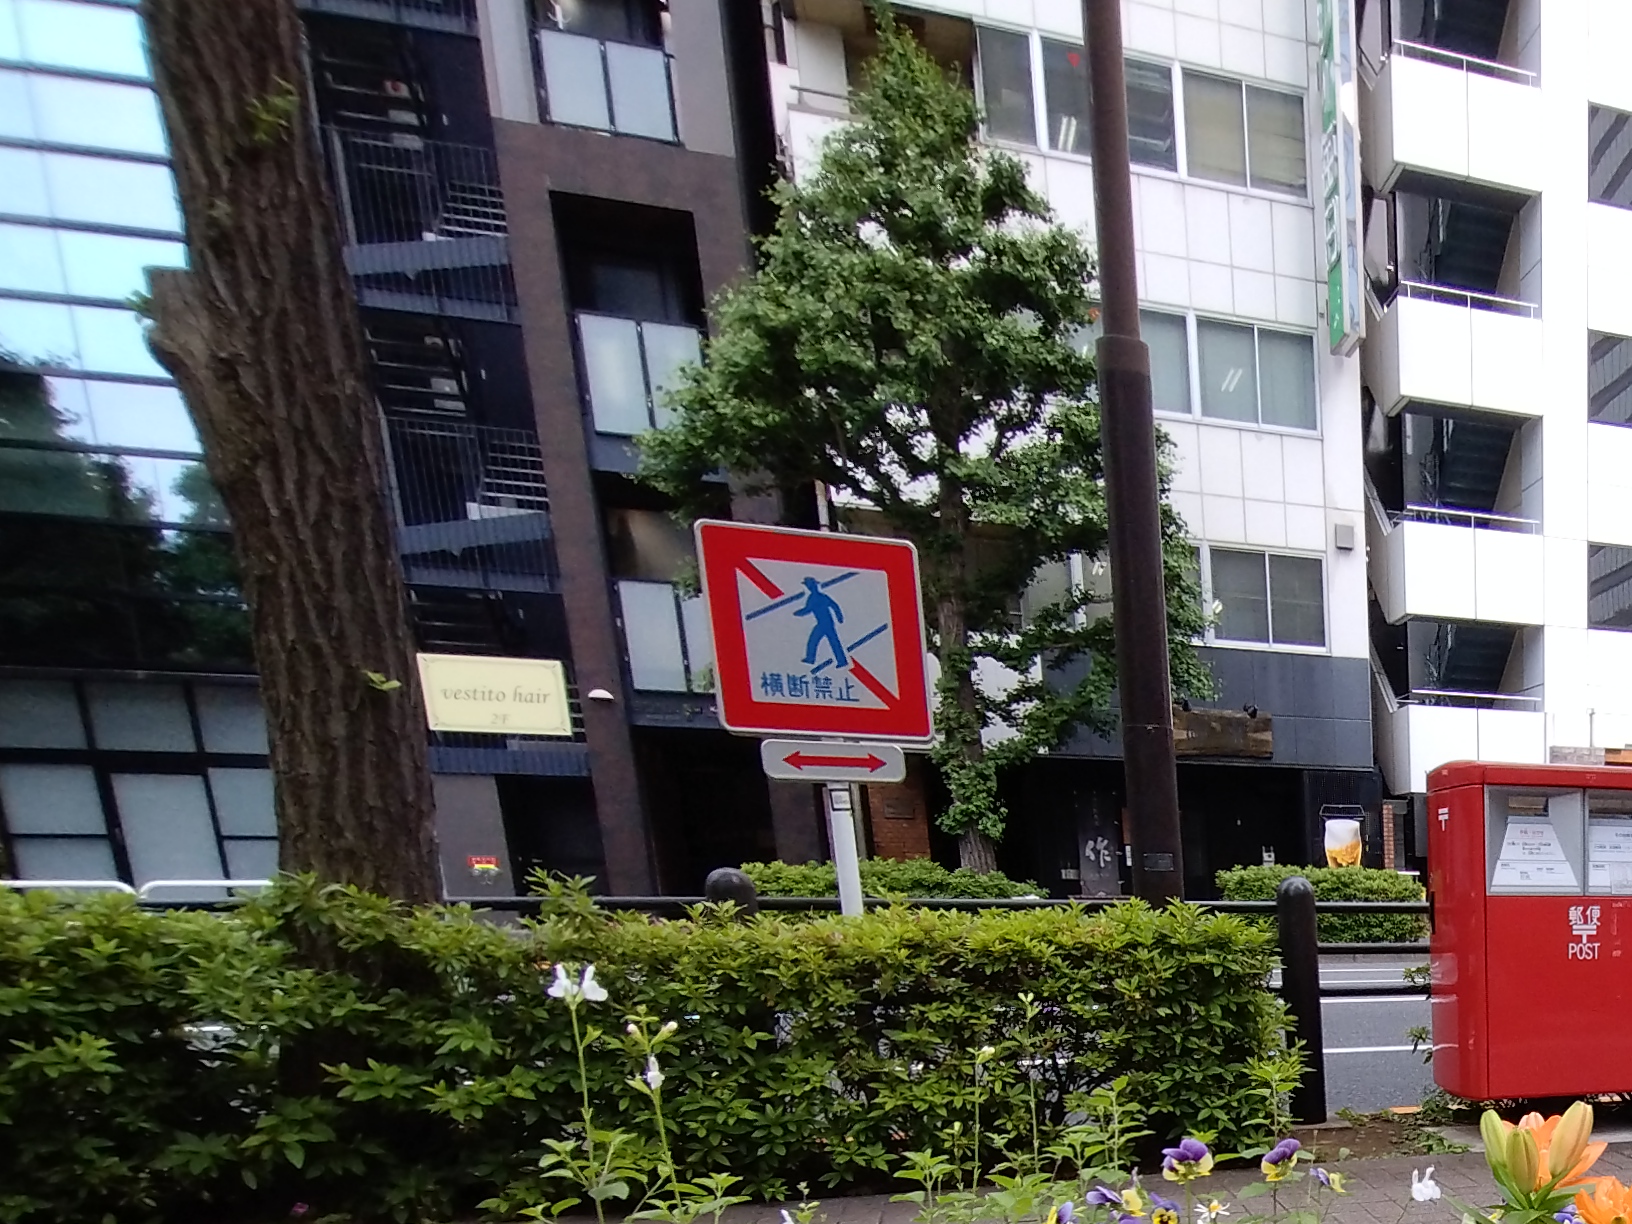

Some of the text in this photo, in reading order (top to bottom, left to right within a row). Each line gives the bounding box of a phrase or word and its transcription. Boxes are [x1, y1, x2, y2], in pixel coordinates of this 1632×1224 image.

[440, 685, 551, 704] vestito hair
[760, 671, 860, 702] 横断禁止
[1568, 905, 1601, 926] 郵便
[1568, 942, 1601, 960] POST
